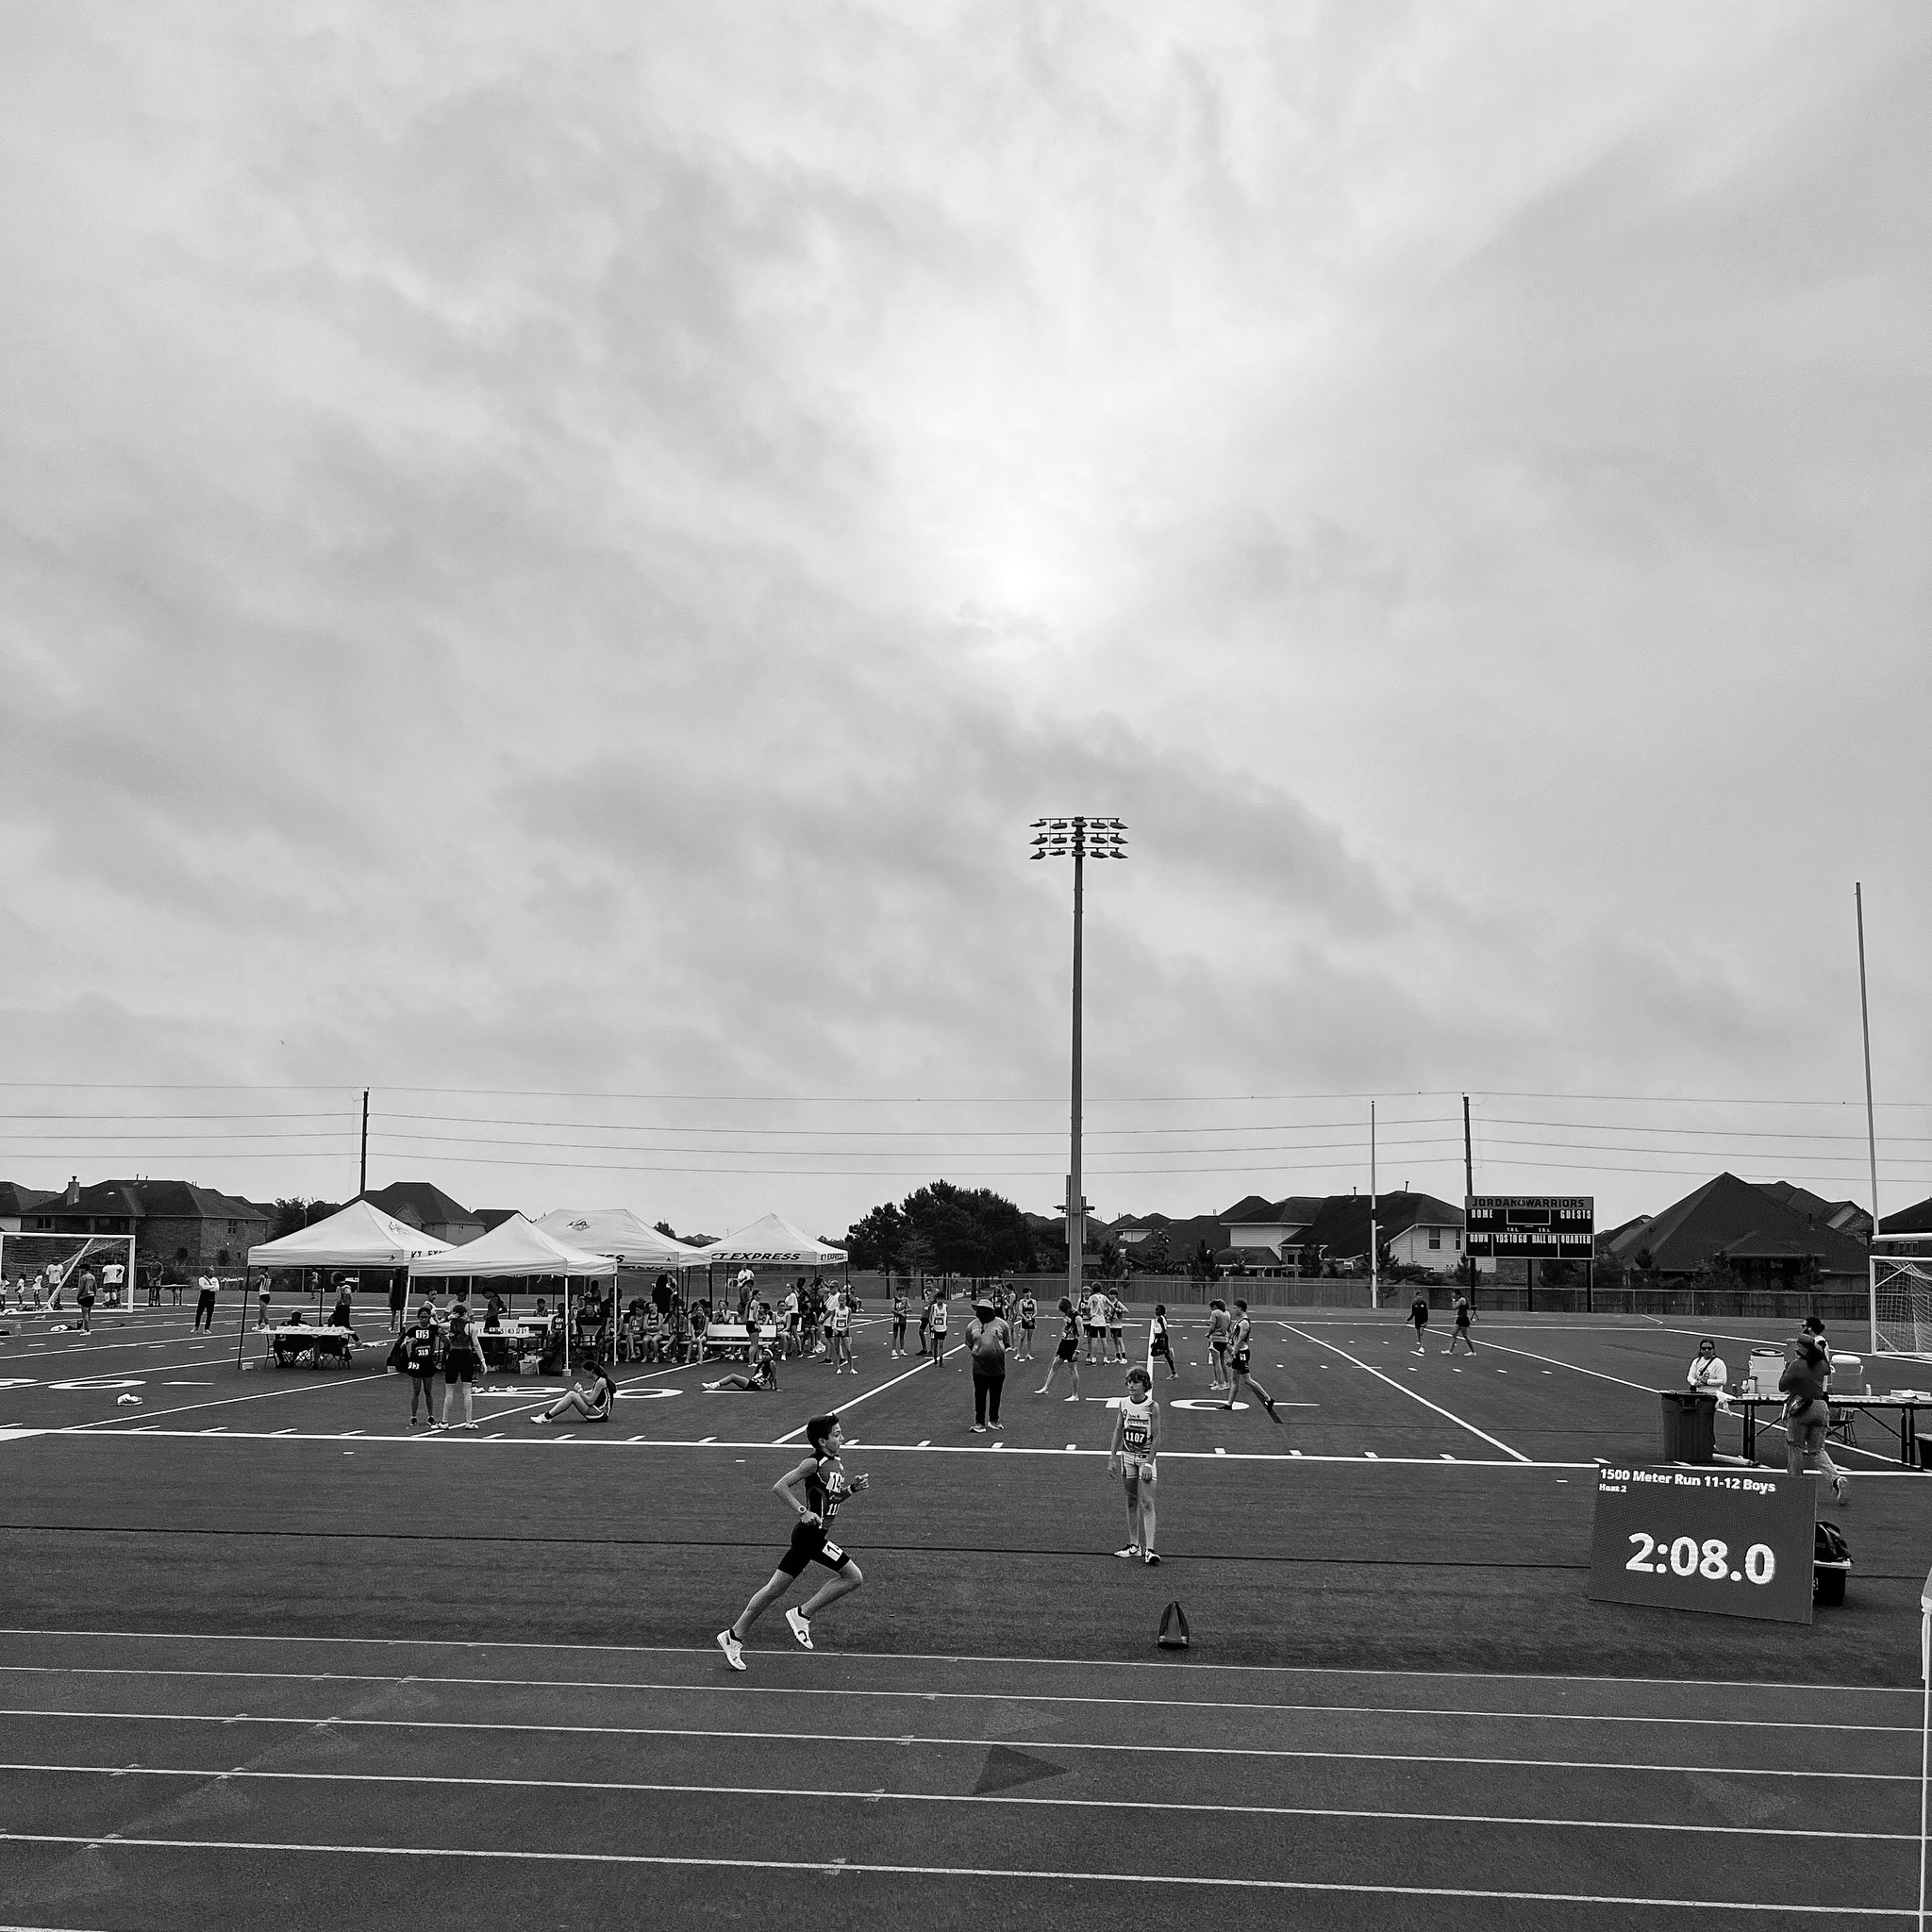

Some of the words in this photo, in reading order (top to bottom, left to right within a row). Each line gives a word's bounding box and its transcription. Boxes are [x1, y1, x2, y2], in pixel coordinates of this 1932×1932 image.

[1472, 1198, 1517, 1207] JORDAN
[1525, 1199, 1585, 1208] WARRIORS
[1471, 1208, 1493, 1218] HOME
[1560, 1209, 1591, 1219] GUESTS
[1470, 1234, 1489, 1242] DOWN
[1495, 1234, 1508, 1243] YDS
[1532, 1235, 1547, 1244] BALL
[1561, 1235, 1591, 1244] QUARTER
[416, 1330, 429, 1339] 15
[1125, 1431, 1145, 1443] 1107
[1600, 1469, 1630, 1481] 1500
[1633, 1471, 1673, 1484] Meter
[1674, 1474, 1701, 1486] Run
[1705, 1475, 1740, 1490] 11-12
[1743, 1479, 1776, 1494] Boys
[1625, 1532, 1775, 1585] 2:08.0
